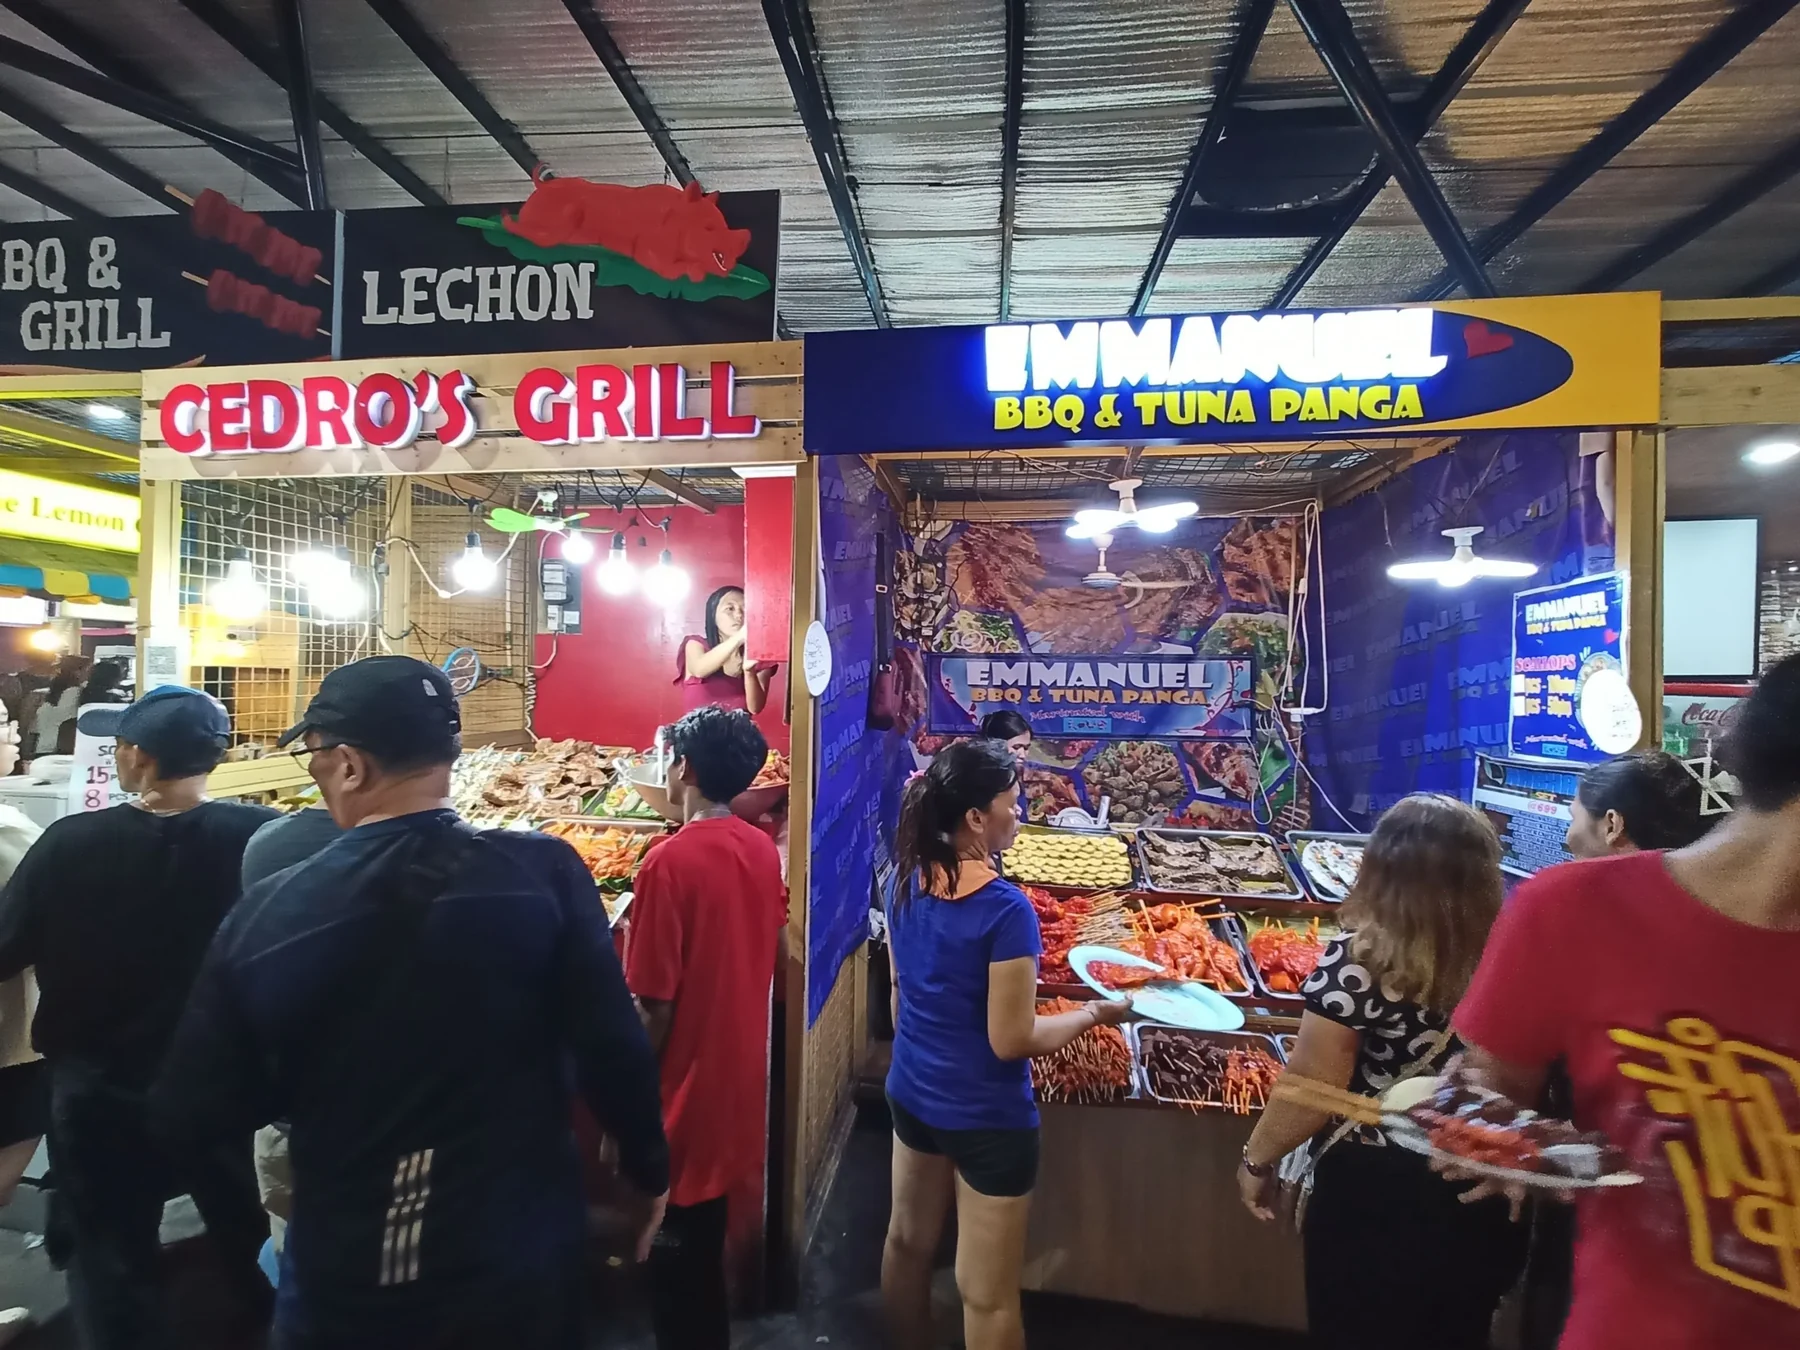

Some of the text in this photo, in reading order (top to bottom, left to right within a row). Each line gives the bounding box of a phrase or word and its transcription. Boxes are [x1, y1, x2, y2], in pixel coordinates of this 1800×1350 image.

[87, 236, 121, 290] &
[362, 262, 595, 325] LECHON
[20, 297, 171, 352] GRILL
[984, 307, 1448, 392] EMMANUEL
[160, 361, 762, 457] CEDRO'S GRILL
[993, 383, 1424, 433] BBQ & TUNA PANGA
[32, 496, 125, 532] Lemon
[966, 660, 1213, 689] EMMANUEL
[970, 687, 1209, 705] BBQ & TUNA PANGA
[85, 789, 101, 808] 8
[86, 766, 109, 784] 15
